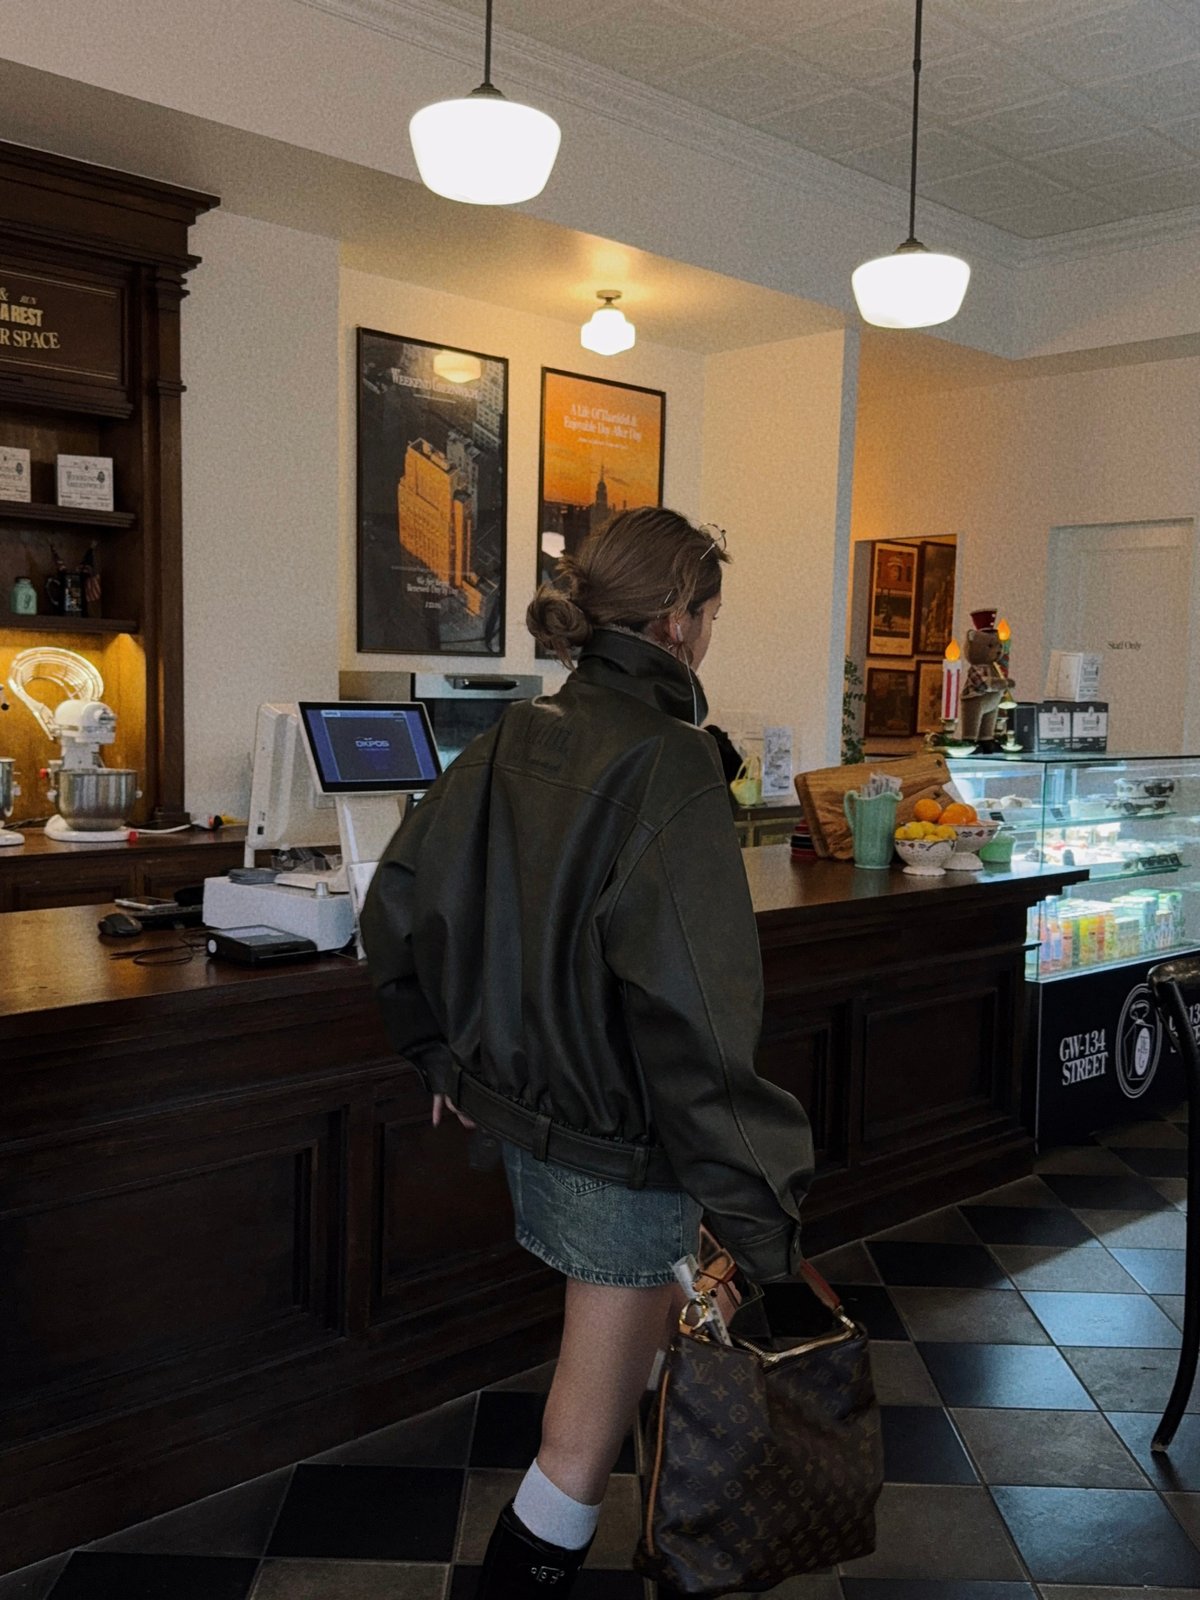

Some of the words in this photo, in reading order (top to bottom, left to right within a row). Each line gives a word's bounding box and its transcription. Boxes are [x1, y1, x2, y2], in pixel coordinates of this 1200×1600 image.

[11, 305, 44, 327] REST
[13, 330, 61, 349] SPACE
[1108, 641, 1124, 650] Staff
[1125, 641, 1142, 651] Only
[1059, 1028, 1106, 1062] GW-134
[1062, 1051, 1108, 1086] STREET
